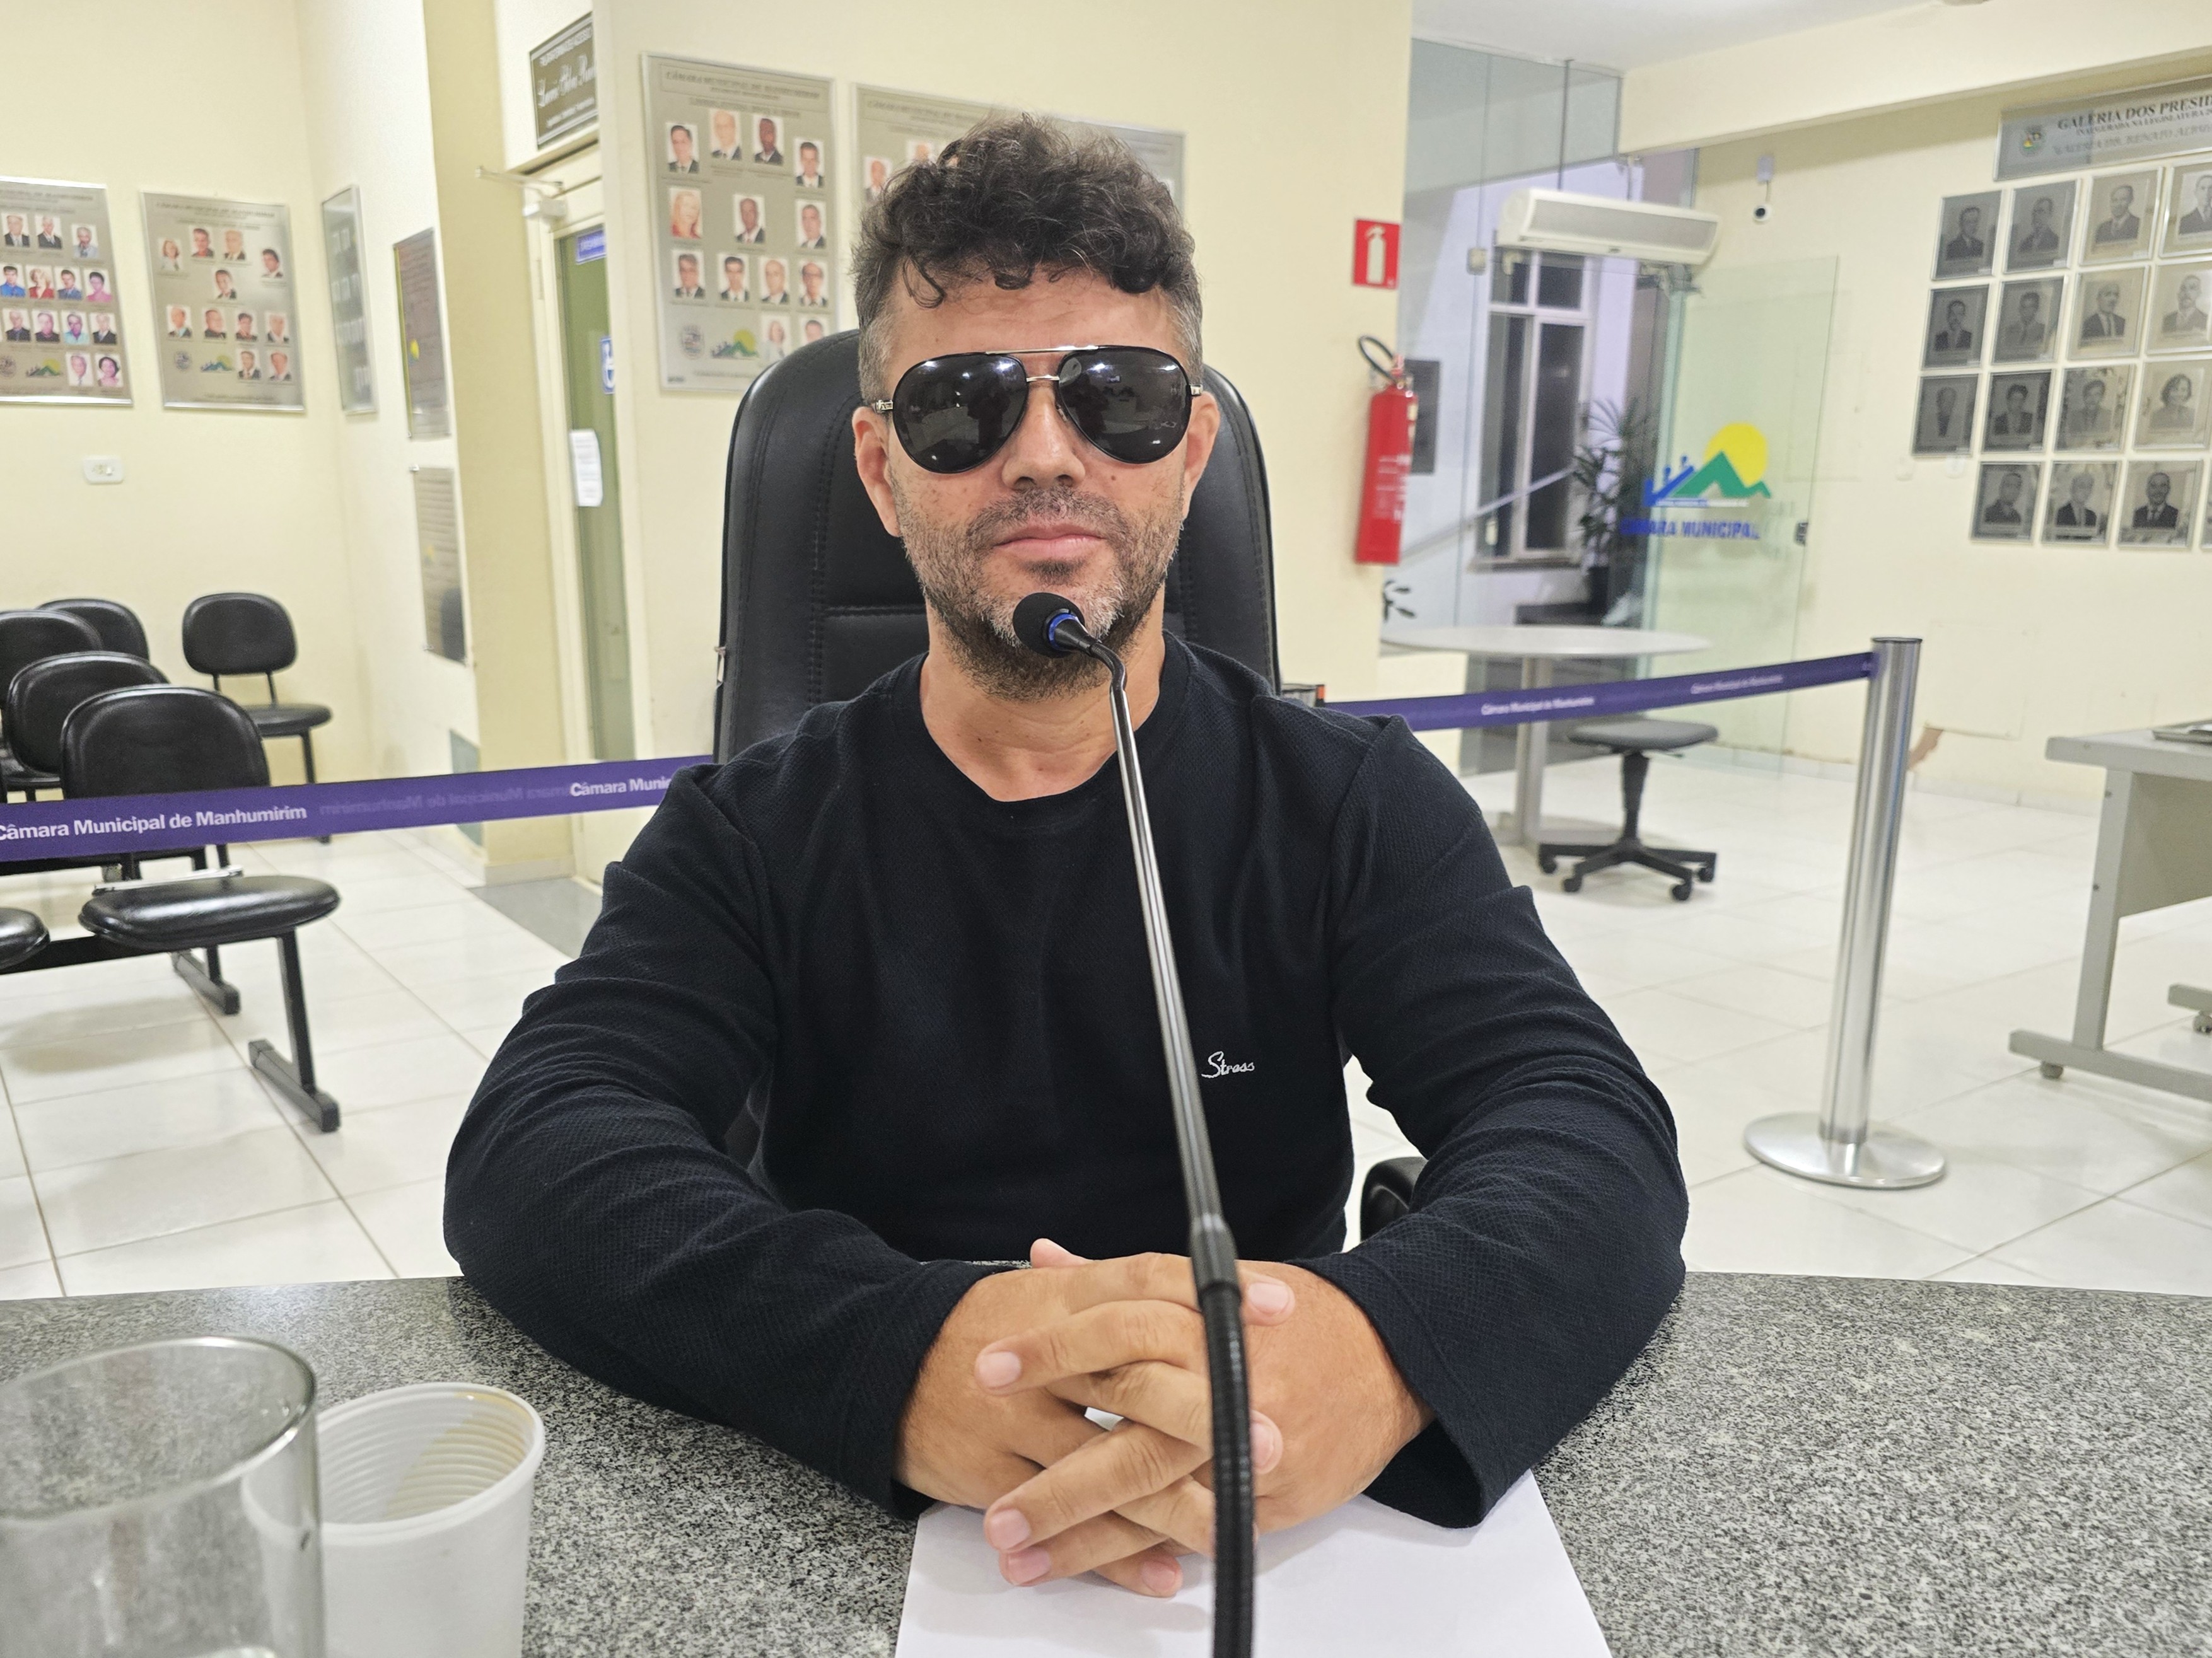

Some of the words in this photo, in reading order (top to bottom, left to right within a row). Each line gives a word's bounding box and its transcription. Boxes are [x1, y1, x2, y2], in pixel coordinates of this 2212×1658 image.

[2058, 110, 2121, 130] GALERIA
[2126, 104, 2157, 119] DOS
[569, 781, 627, 797] Câmara
[74, 815, 165, 836] Municipal
[169, 812, 193, 829] de
[196, 806, 307, 826] Manhumirim
[1201, 1051, 1255, 1079] Stress
